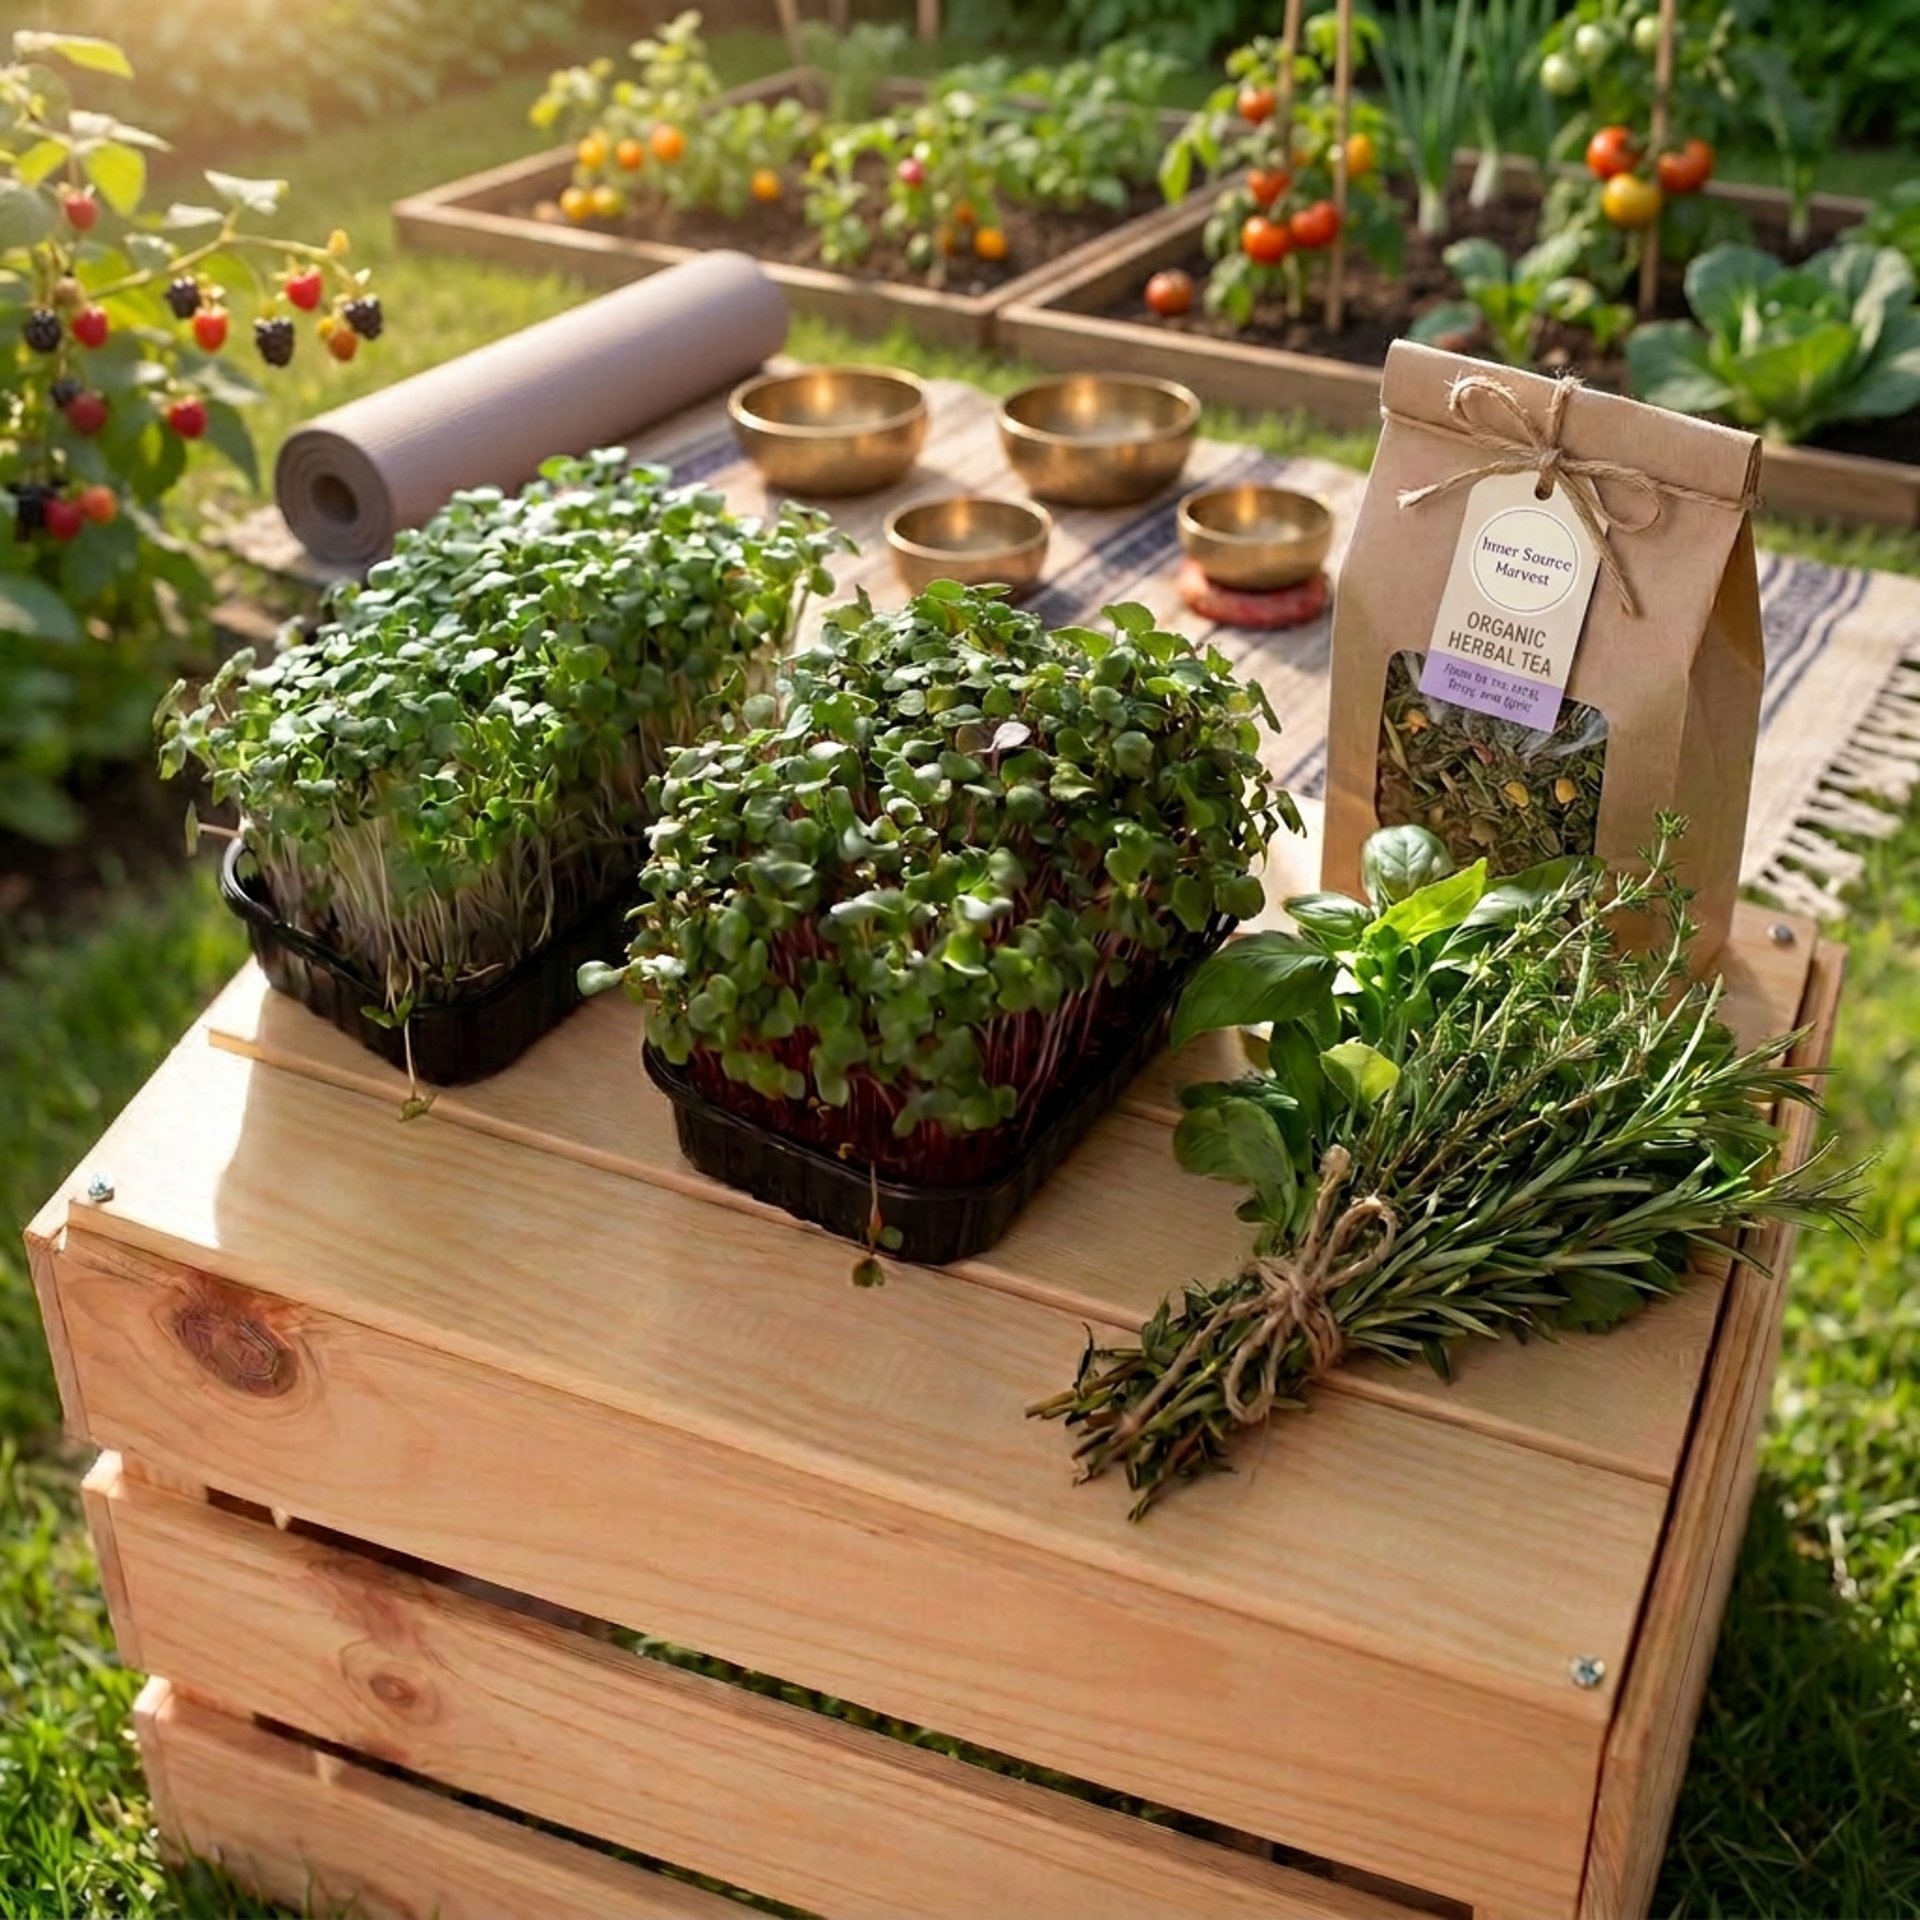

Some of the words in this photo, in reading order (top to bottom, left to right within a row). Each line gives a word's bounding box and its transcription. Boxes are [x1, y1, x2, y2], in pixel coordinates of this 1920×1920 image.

[1522, 547, 1572, 572] Source
[1467, 611, 1546, 648] ORGANIC
[1448, 630, 1515, 667] HERBAL
[1522, 652, 1551, 677] TEA
